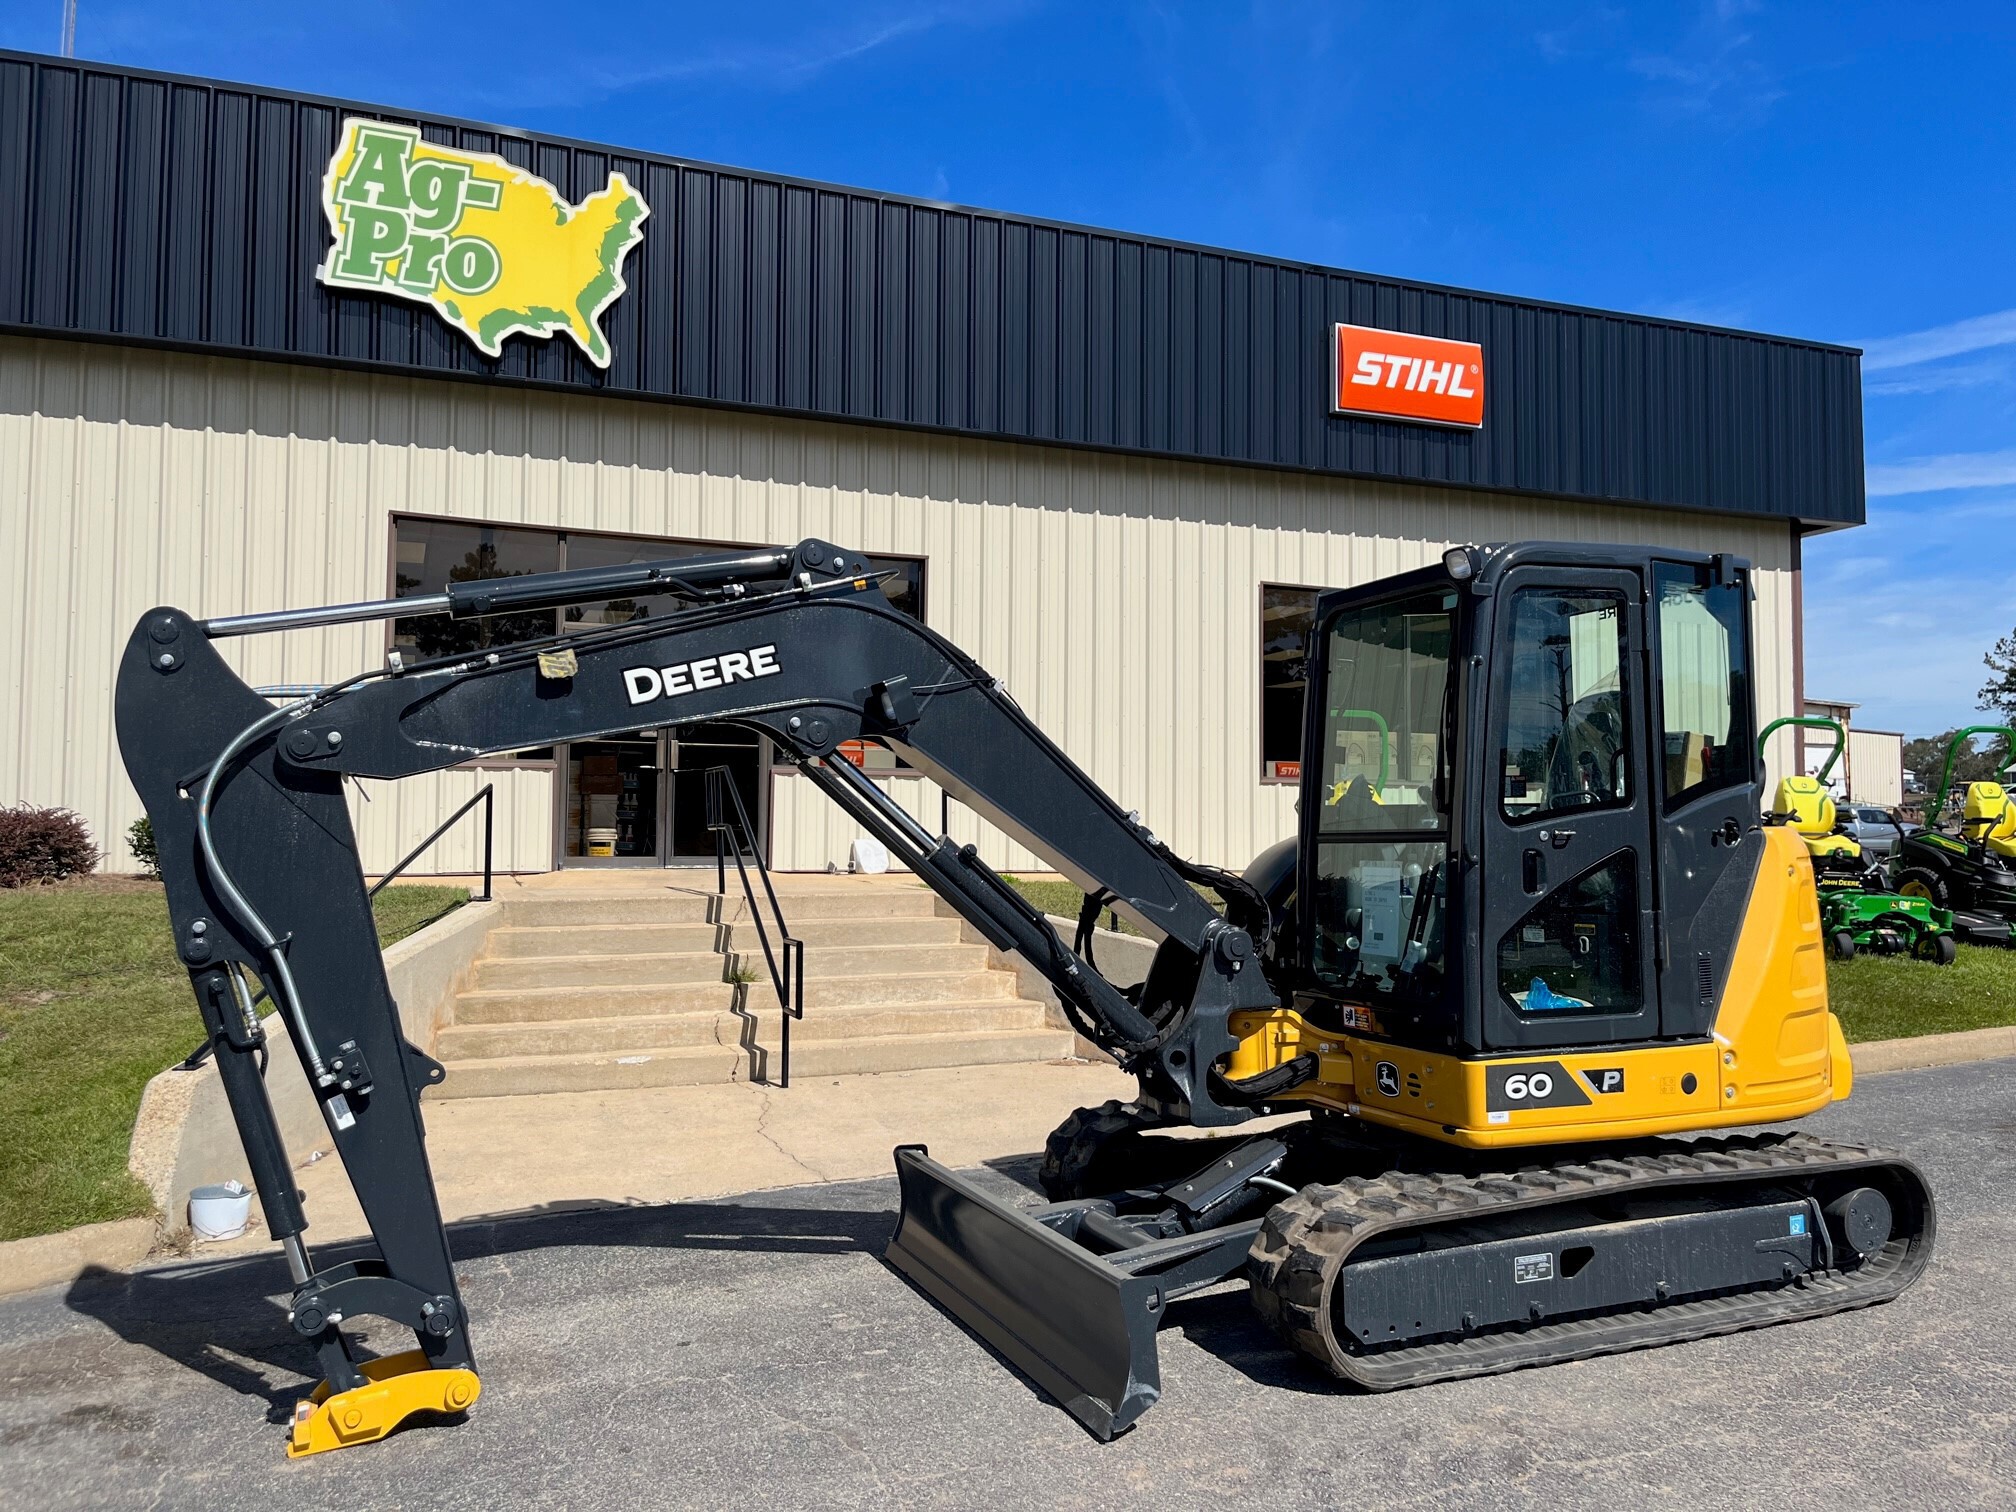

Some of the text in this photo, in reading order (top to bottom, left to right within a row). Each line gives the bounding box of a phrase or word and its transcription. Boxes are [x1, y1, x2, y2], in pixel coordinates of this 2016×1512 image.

[335, 126, 503, 234] Ag-
[335, 205, 501, 294] Pro
[1351, 351, 1475, 399] STIHL
[623, 644, 781, 705] DEERE
[1838, 879, 1860, 887] DEERE
[1504, 1073, 1553, 1100] 60
[1602, 1071, 1621, 1091] P
